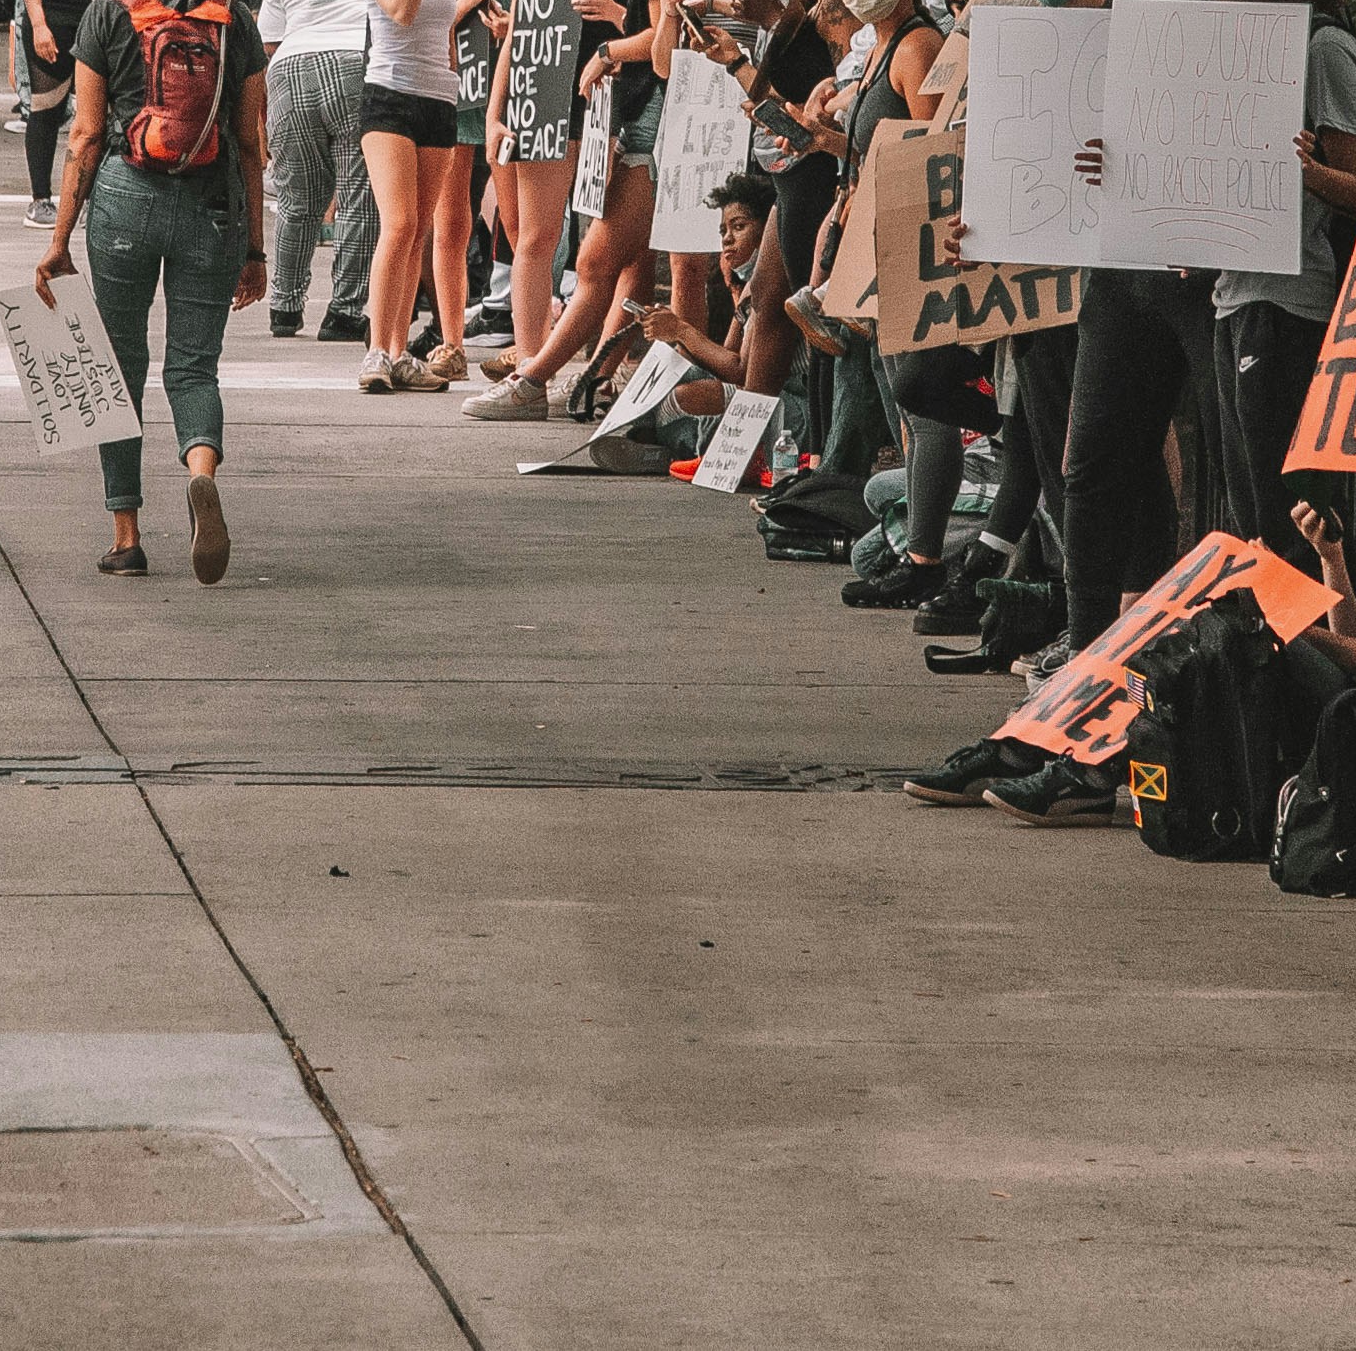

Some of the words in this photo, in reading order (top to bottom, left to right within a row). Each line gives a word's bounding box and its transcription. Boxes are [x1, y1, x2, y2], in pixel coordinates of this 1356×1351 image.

[511, 24, 572, 67] JUST-
[1128, 11, 1184, 78] NO
[1195, 10, 1298, 86] JUSTICE.
[509, 65, 538, 97] ICE
[506, 99, 536, 130] NO
[518, 118, 568, 161] EACE
[682, 115, 736, 157] LIVES
[1126, 87, 1175, 146] NO
[1192, 89, 1269, 150] PEACE.
[656, 159, 744, 214] MATT
[1120, 152, 1148, 201] NO
[1163, 154, 1219, 206] RACIST
[1226, 156, 1288, 212] POLICE
[912, 266, 1080, 343] MATT
[0, 301, 60, 445] SOLIDARITY
[41, 349, 71, 411] LOVE
[59, 352, 96, 428] UNITY
